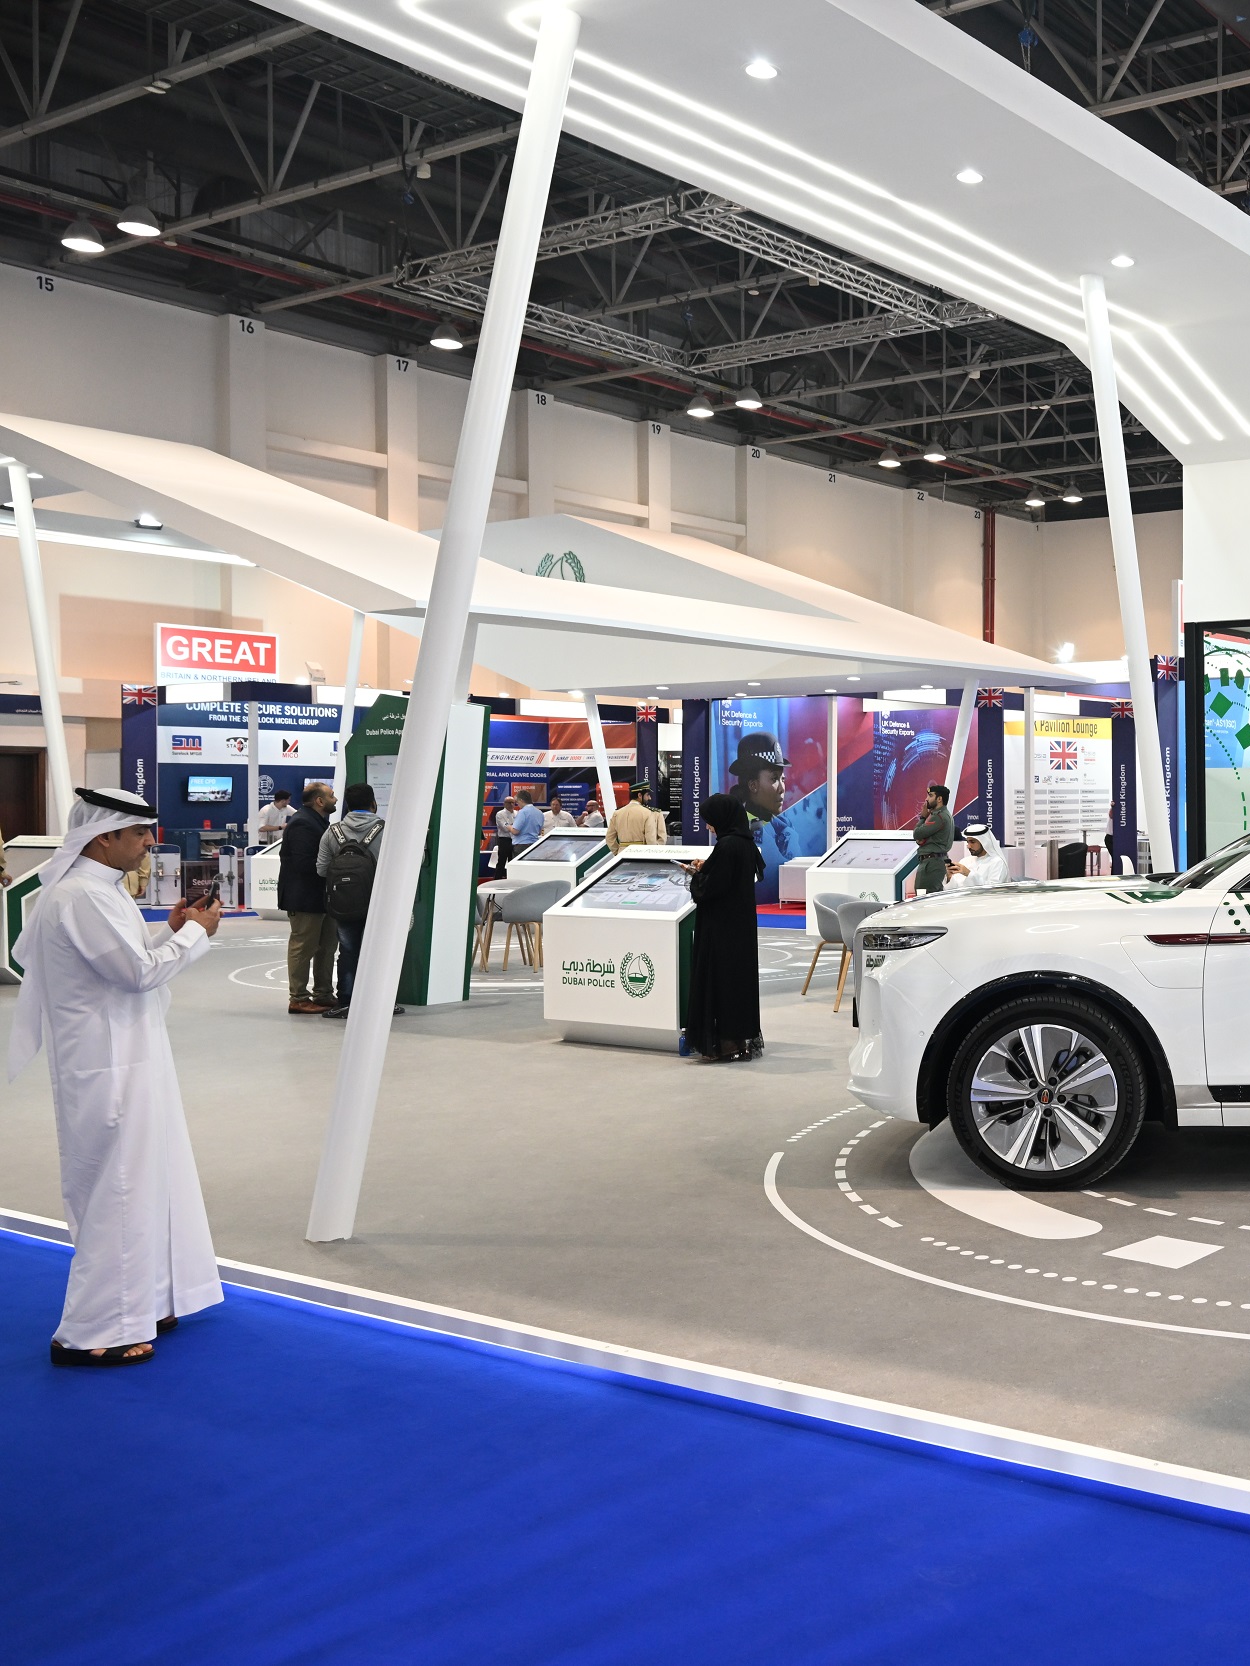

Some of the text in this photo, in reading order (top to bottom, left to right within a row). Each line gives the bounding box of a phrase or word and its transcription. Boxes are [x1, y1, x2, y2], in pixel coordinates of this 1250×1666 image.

[36, 275, 54, 292] 15
[239, 319, 255, 334] 16
[396, 359, 409, 373] 17
[535, 393, 547, 406] 18
[651, 424, 661, 435] 19
[751, 449, 760, 459] 20
[828, 473, 836, 483] 21
[917, 491, 924, 501] 22
[974, 510, 981, 519] 23
[166, 635, 271, 666] GREAT
[160, 671, 191, 680] BRITAIN
[201, 674, 243, 683] NORTHERN
[186, 702, 338, 718] COMPLETE SCURE SOLUTIONS
[722, 710, 731, 718] UK
[731, 710, 752, 719] Defence
[208, 714, 228, 722] FROM
[242, 715, 274, 724] SULOCK
[275, 717, 297, 725] MCGILL
[298, 718, 319, 726] GROUP
[722, 718, 764, 728] Security Exports
[889, 720, 906, 728] Defence
[366, 728, 379, 736] Dubai
[380, 728, 394, 736] Police
[881, 727, 915, 737] Security Exports
[1040, 719, 1070, 733] Pavilion
[1072, 719, 1098, 737] Lounge
[135, 758, 146, 798] Kingdom
[986, 759, 994, 799] Kingdom
[693, 756, 701, 832] United Kingdom
[562, 958, 615, 977] شرطة دبي
[562, 976, 615, 988] DUBAI POLICE
[1115, 1053, 1132, 1113] MICHELIN
